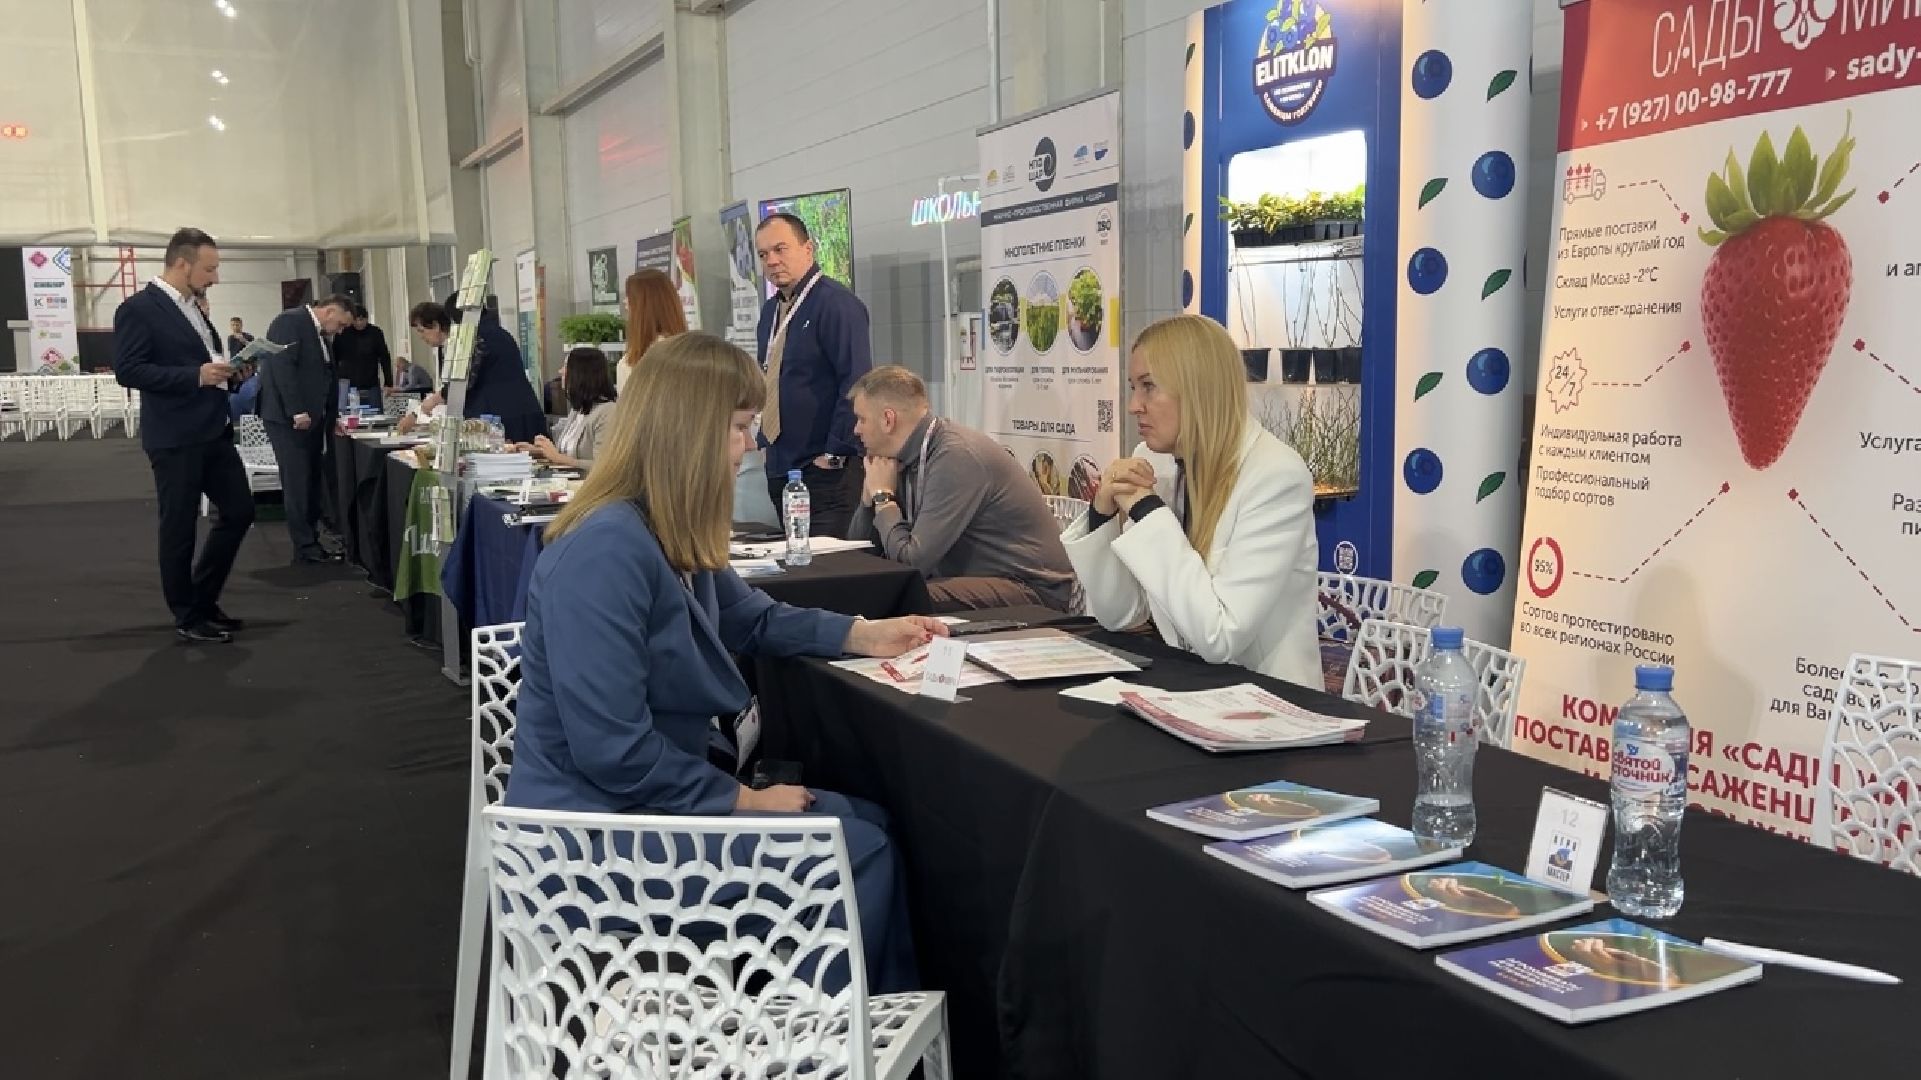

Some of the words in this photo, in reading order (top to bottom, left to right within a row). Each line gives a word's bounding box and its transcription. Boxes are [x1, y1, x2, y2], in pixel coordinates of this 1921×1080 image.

[1652, 0, 1765, 77] САДЫ
[1256, 45, 1334, 86] ELITKLON
[1596, 106, 1618, 131] +7
[1622, 94, 1669, 128] (927)
[1675, 68, 1792, 116] 00-98-777
[1847, 43, 1921, 79] sady-
[1559, 226, 1602, 243] Прямые
[1605, 220, 1656, 237] поставки
[1558, 249, 1569, 260] из
[1572, 243, 1612, 260] Европы
[1615, 236, 1660, 256] круглый
[1663, 236, 1684, 250] год
[1556, 274, 1587, 288] Склад
[1590, 271, 1630, 286] Москва
[1886, 264, 1898, 276] и
[1554, 305, 1588, 321] Услуги
[1591, 301, 1682, 318] ответ-хранения
[1541, 424, 1630, 444] Индивидуальная
[1632, 430, 1682, 447] работа
[1538, 446, 1544, 454] с
[1546, 446, 1586, 460] каждым
[1590, 449, 1650, 464] клиентом
[1536, 466, 1649, 490] Профессиональный
[1535, 486, 1570, 502] подбор
[1573, 491, 1614, 506] сортов
[1534, 559, 1552, 575] 95%
[1522, 602, 1559, 623] Сортов
[1562, 612, 1674, 646] протестировано
[1520, 622, 1530, 632] во
[1533, 625, 1557, 640] всех
[1560, 630, 1620, 654] регионах
[1624, 641, 1674, 665] России
[1796, 656, 1845, 680] Боле
[1770, 698, 1800, 716] для
[1561, 808, 1580, 828] 12
